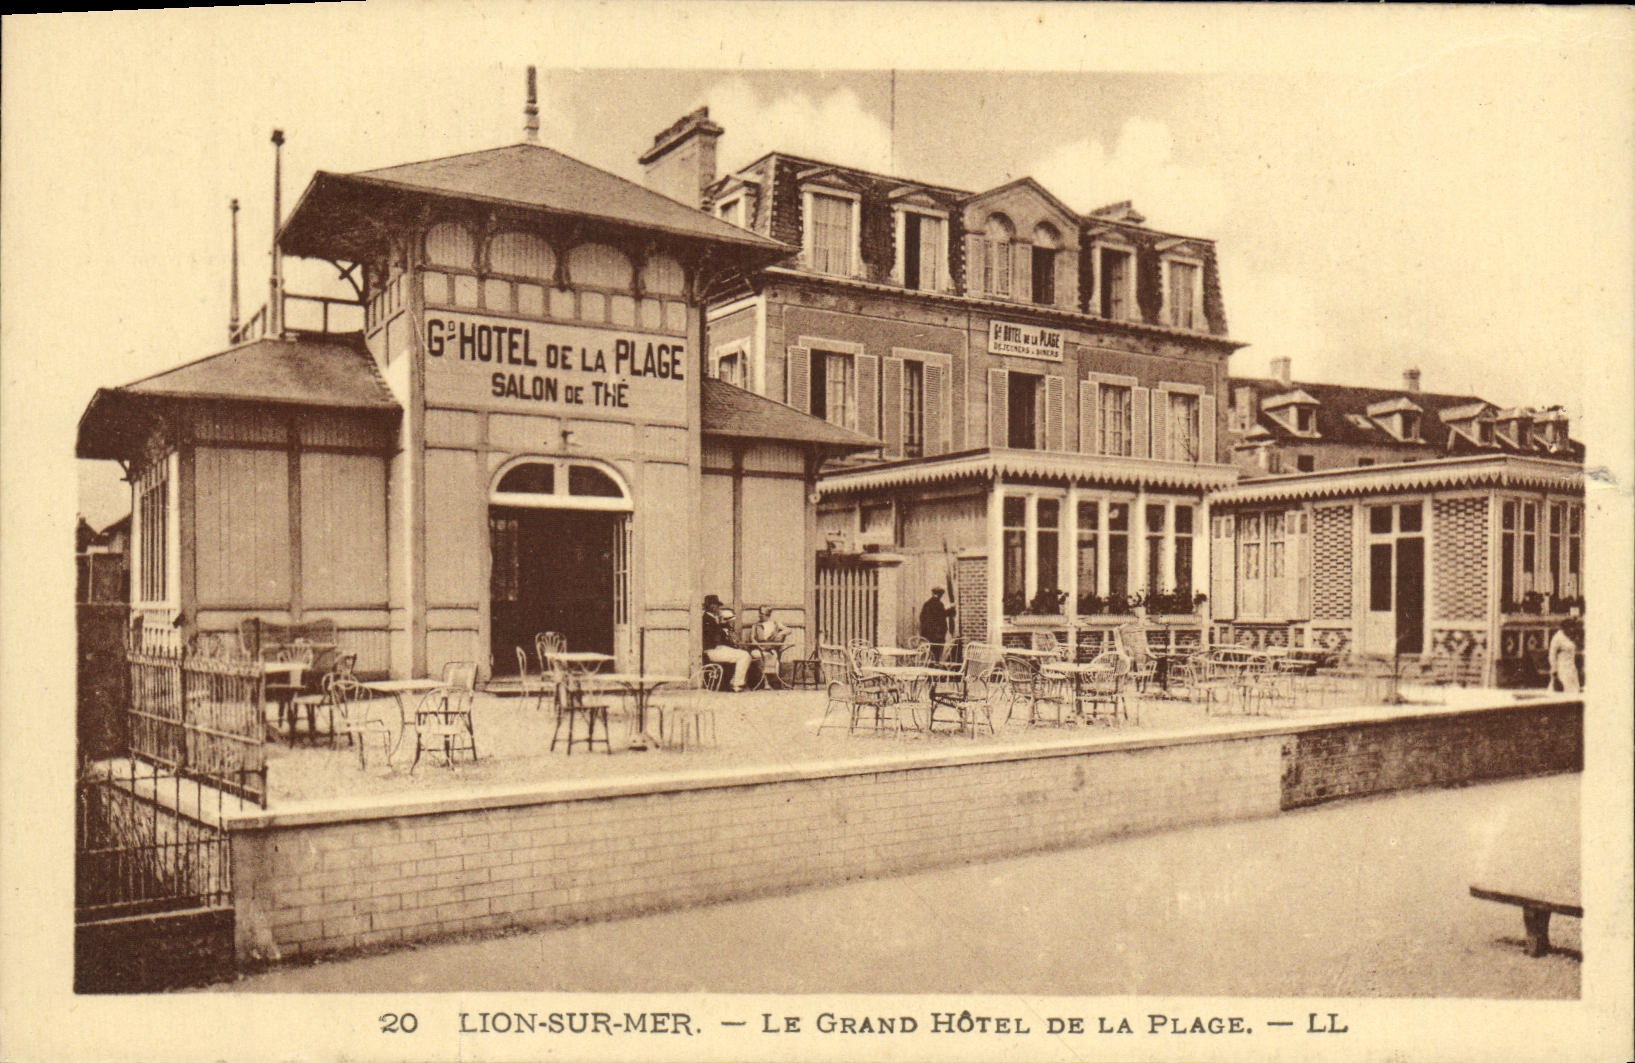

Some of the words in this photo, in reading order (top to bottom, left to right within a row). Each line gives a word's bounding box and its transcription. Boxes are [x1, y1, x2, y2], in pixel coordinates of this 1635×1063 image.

[459, 321, 537, 367] HOTEL
[546, 344, 573, 370] DE
[581, 347, 606, 374] LA
[615, 338, 684, 381] PLAGE
[1031, 336, 1038, 346] LA
[1040, 330, 1060, 348] PLAGE
[492, 372, 558, 402] SALON
[565, 385, 584, 405] DE
[592, 377, 629, 408] THÉ
